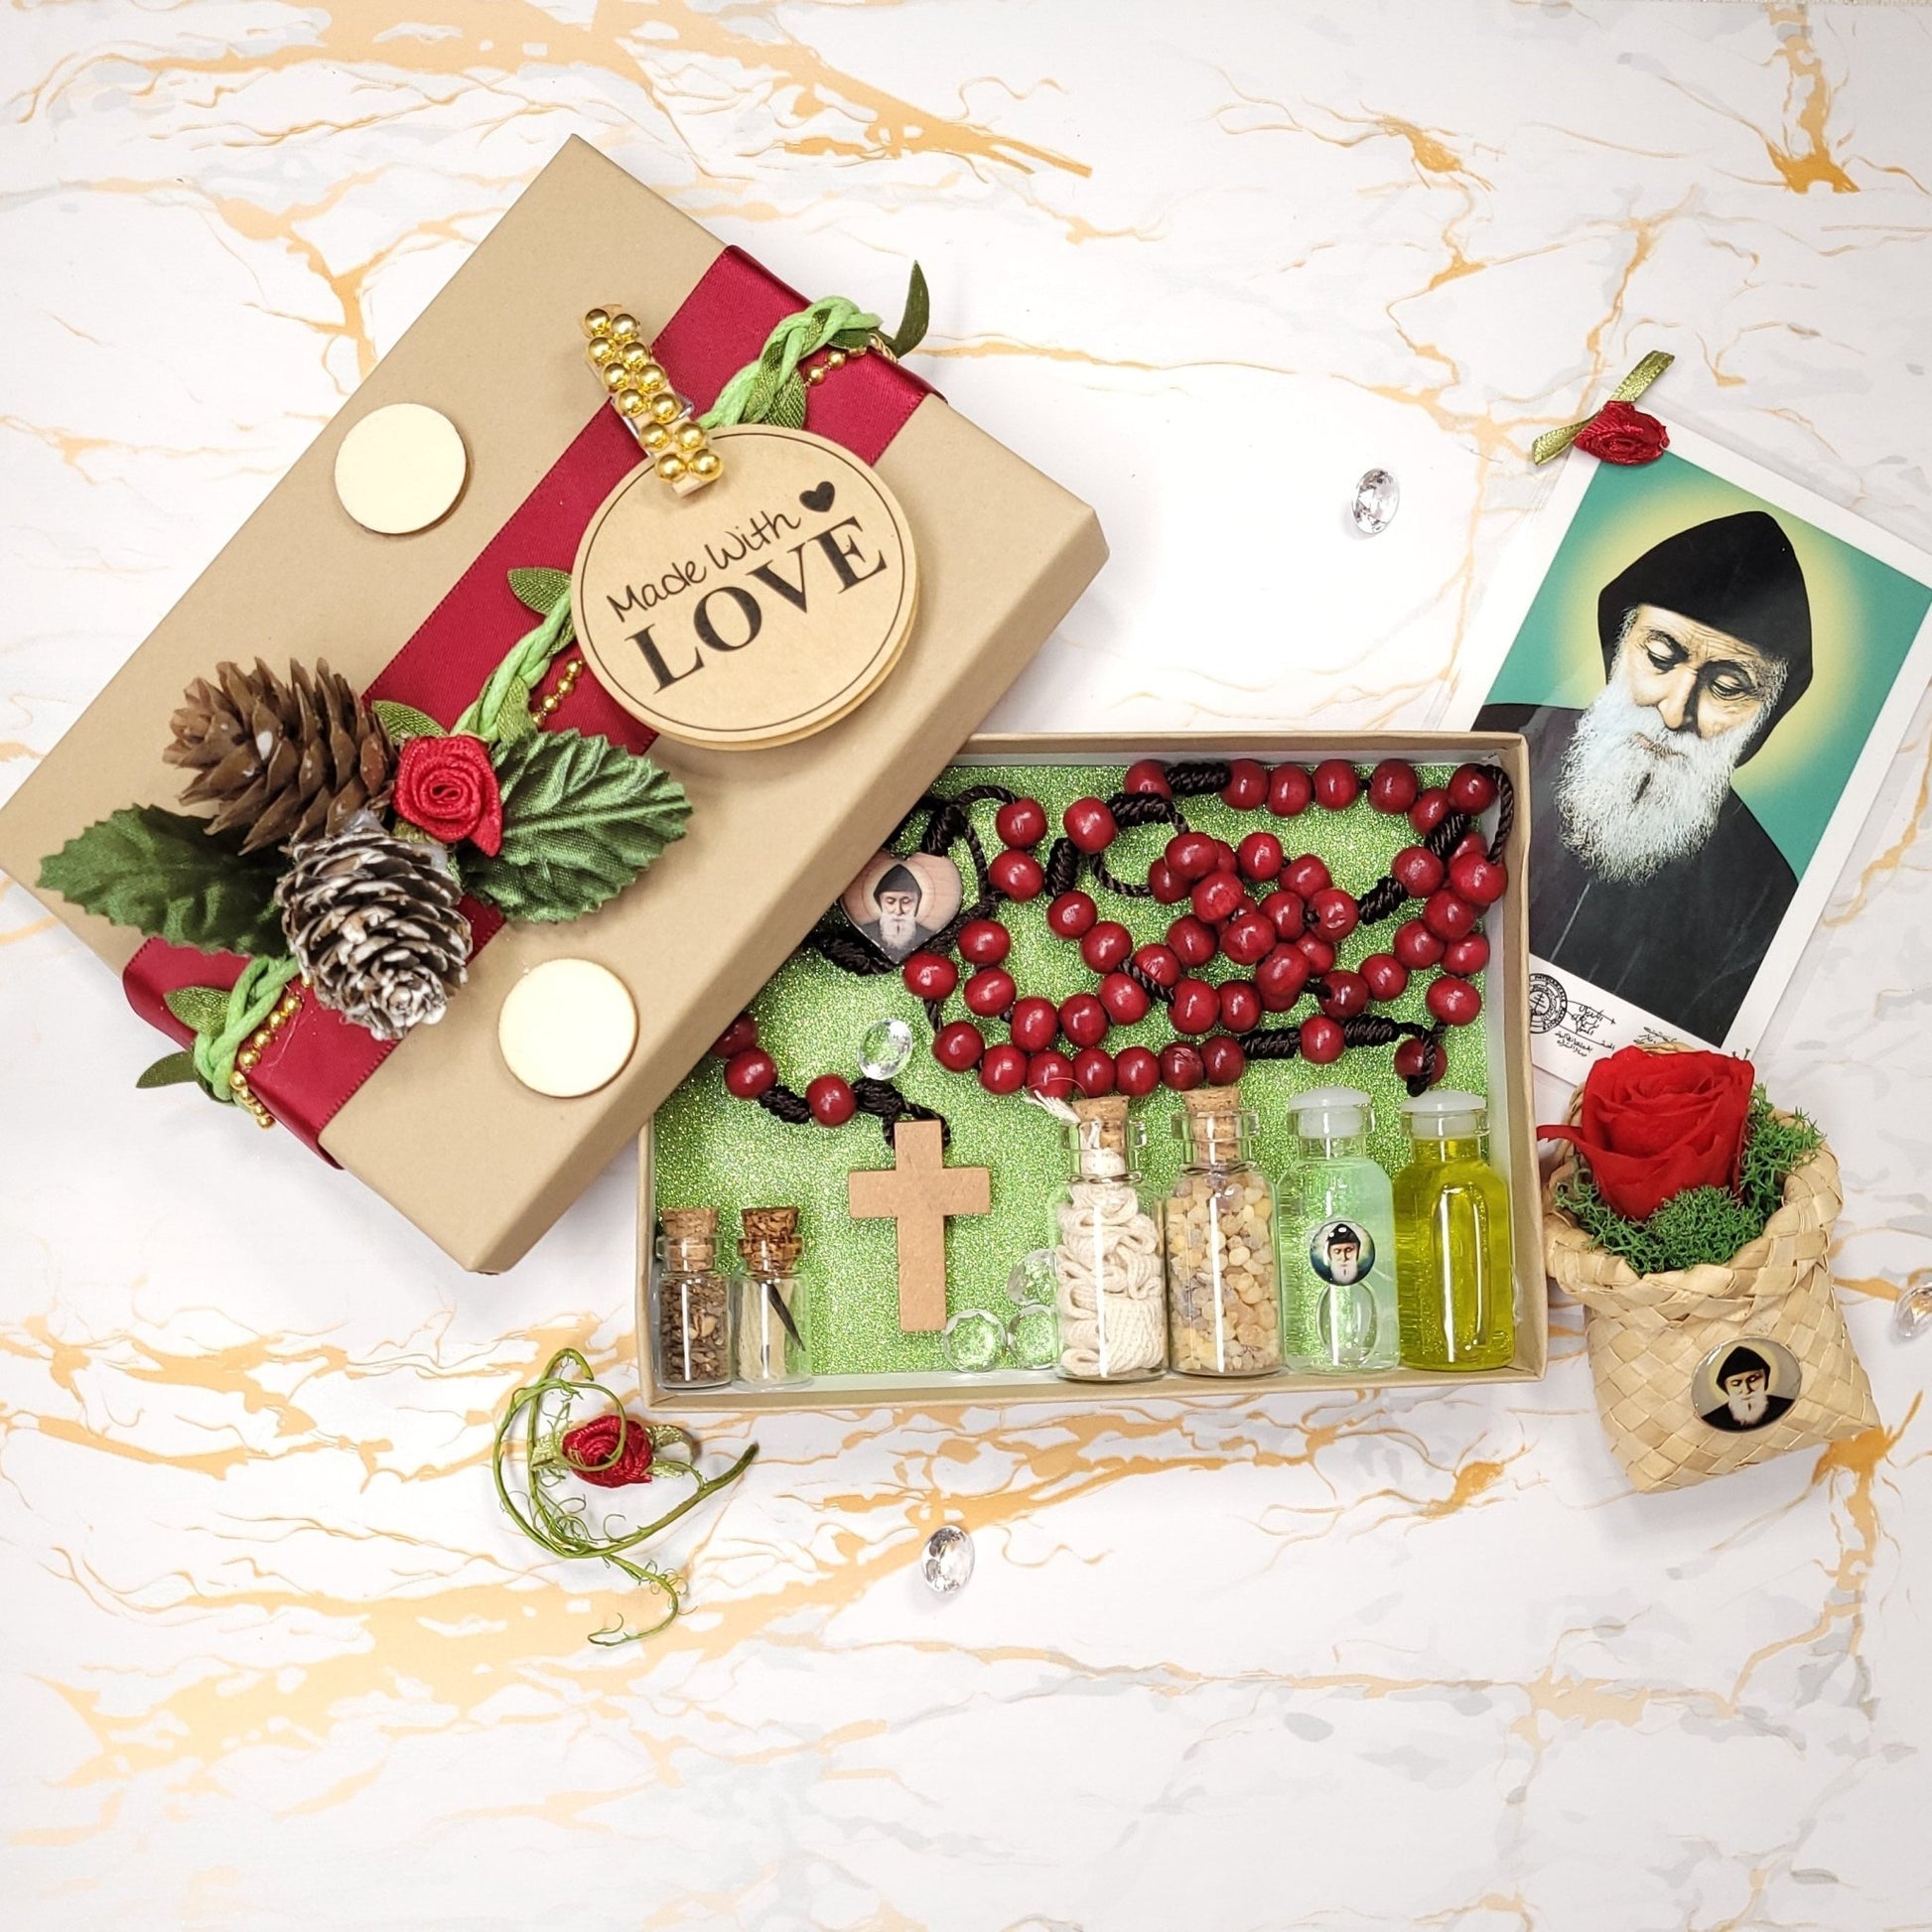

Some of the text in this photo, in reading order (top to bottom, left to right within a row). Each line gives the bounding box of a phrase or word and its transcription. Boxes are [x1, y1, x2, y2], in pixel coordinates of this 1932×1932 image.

[606, 510, 801, 622] Made With
[624, 516, 888, 695] LOVE
